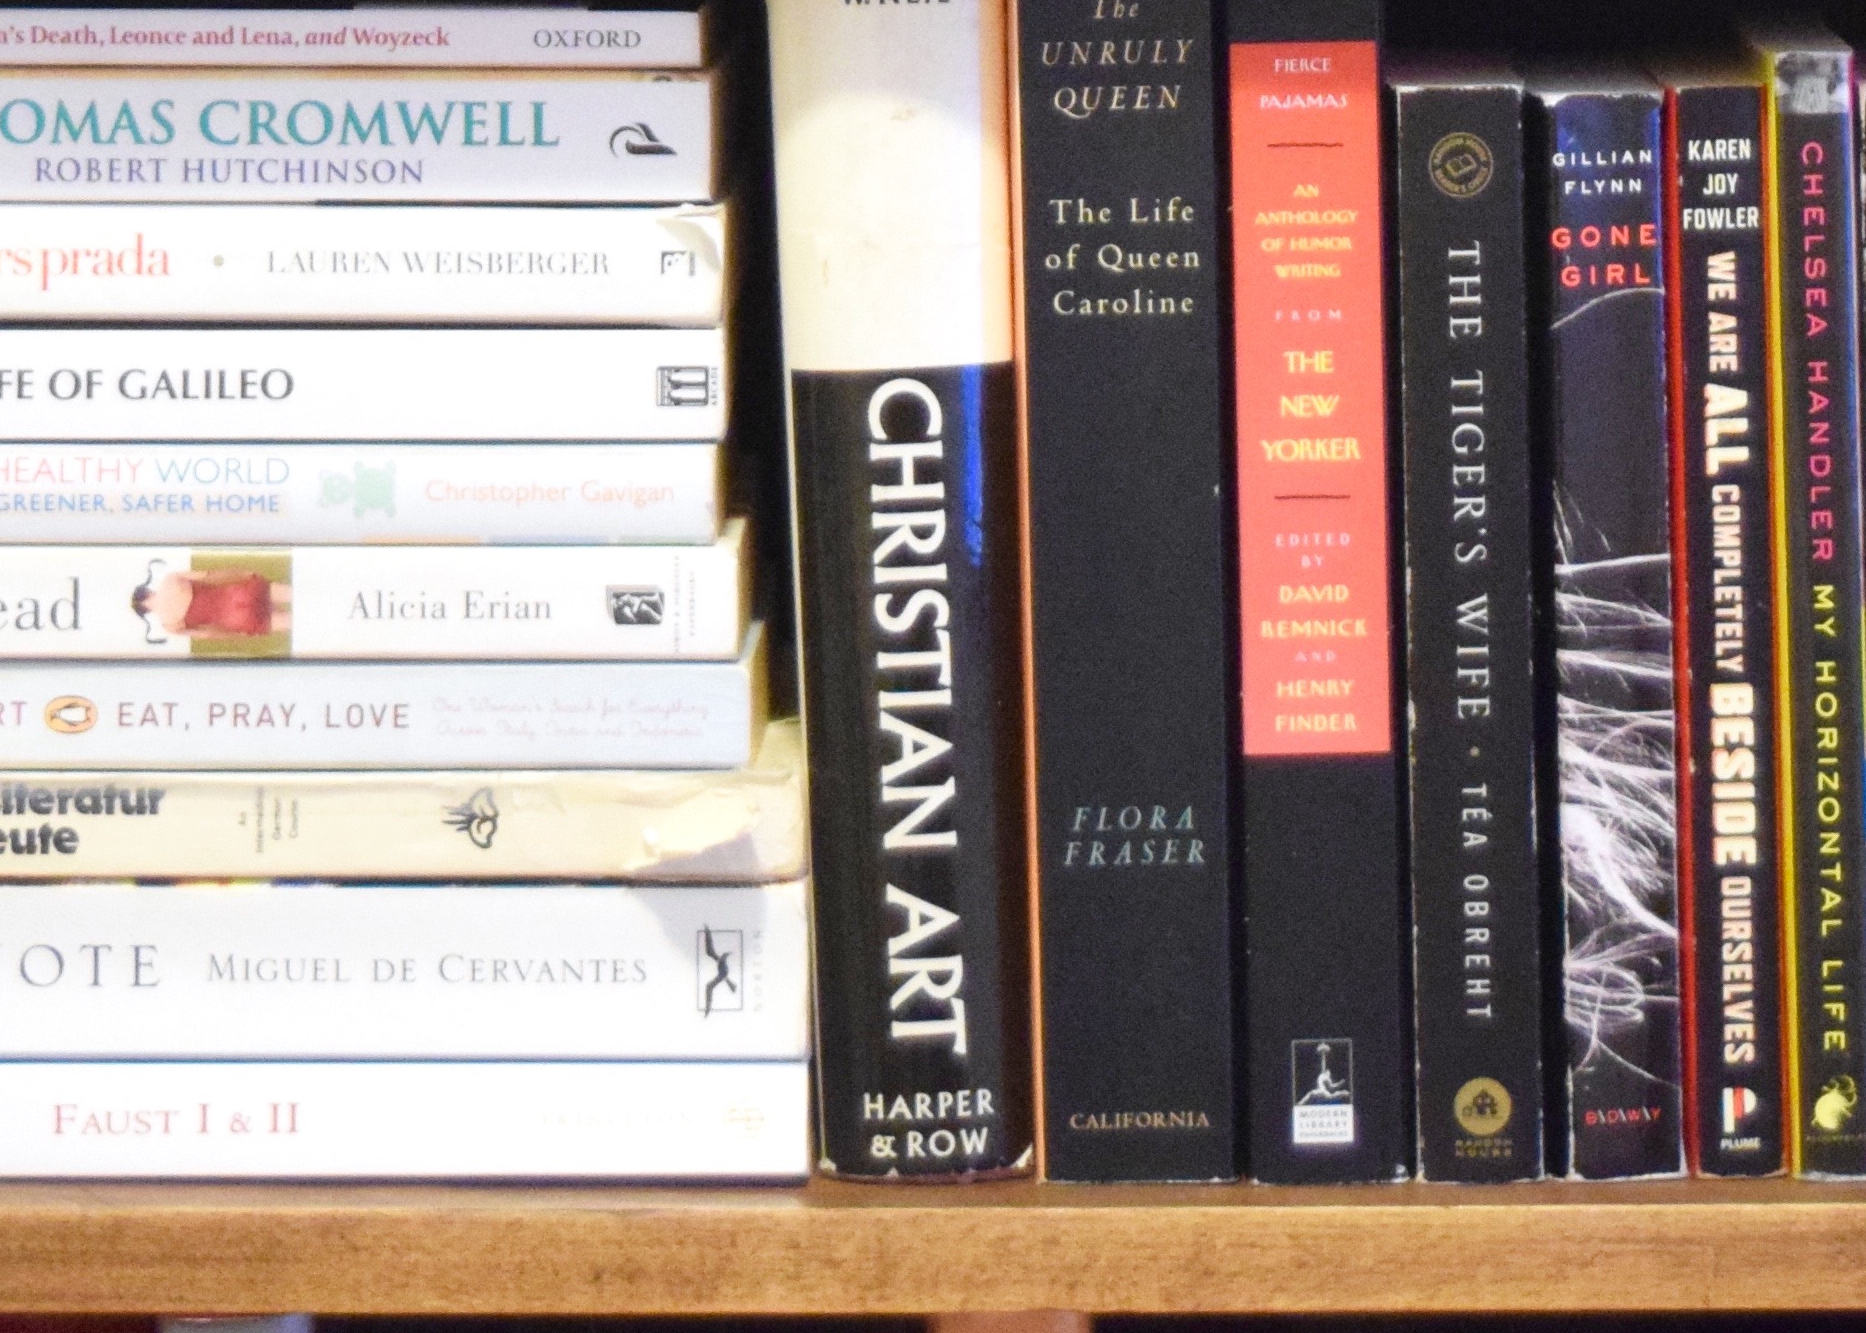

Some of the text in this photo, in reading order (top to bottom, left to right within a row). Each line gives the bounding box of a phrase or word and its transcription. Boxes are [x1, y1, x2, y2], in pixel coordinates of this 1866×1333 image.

[31, 25, 105, 47] Death,
[109, 27, 185, 46] Leonce
[193, 27, 234, 47] and
[241, 27, 299, 48] Lena,
[305, 27, 347, 47] and
[352, 27, 449, 51] Woyzeck
[533, 29, 641, 49] OXFORD
[1041, 38, 1192, 68] UNRULY
[1053, 84, 1180, 114] QUEEN
[199, 99, 561, 148] CROMWELL
[1553, 148, 1653, 165] GILLIAN
[1688, 139, 1751, 161] KAREN
[35, 158, 424, 184] ROBERT HUTCHINSON
[1564, 179, 1642, 193] FLYNN
[1703, 174, 1738, 195] JOY
[1050, 200, 1195, 225] The Life
[1683, 208, 1759, 230] FOWLER
[1551, 225, 1656, 247] GONE
[1045, 243, 1200, 271] of Queen
[1561, 265, 1650, 286] GIRL
[1053, 289, 1194, 314] Caroline
[48, 369, 103, 401] OF
[118, 369, 294, 401] GALILEO
[347, 591, 446, 621] Alicia
[463, 592, 552, 620] Erian
[118, 701, 190, 730] EAT,
[209, 705, 306, 732] PRAY,
[325, 703, 409, 729] LOVE
[867, 377, 967, 1056] CHRISTIAN ART
